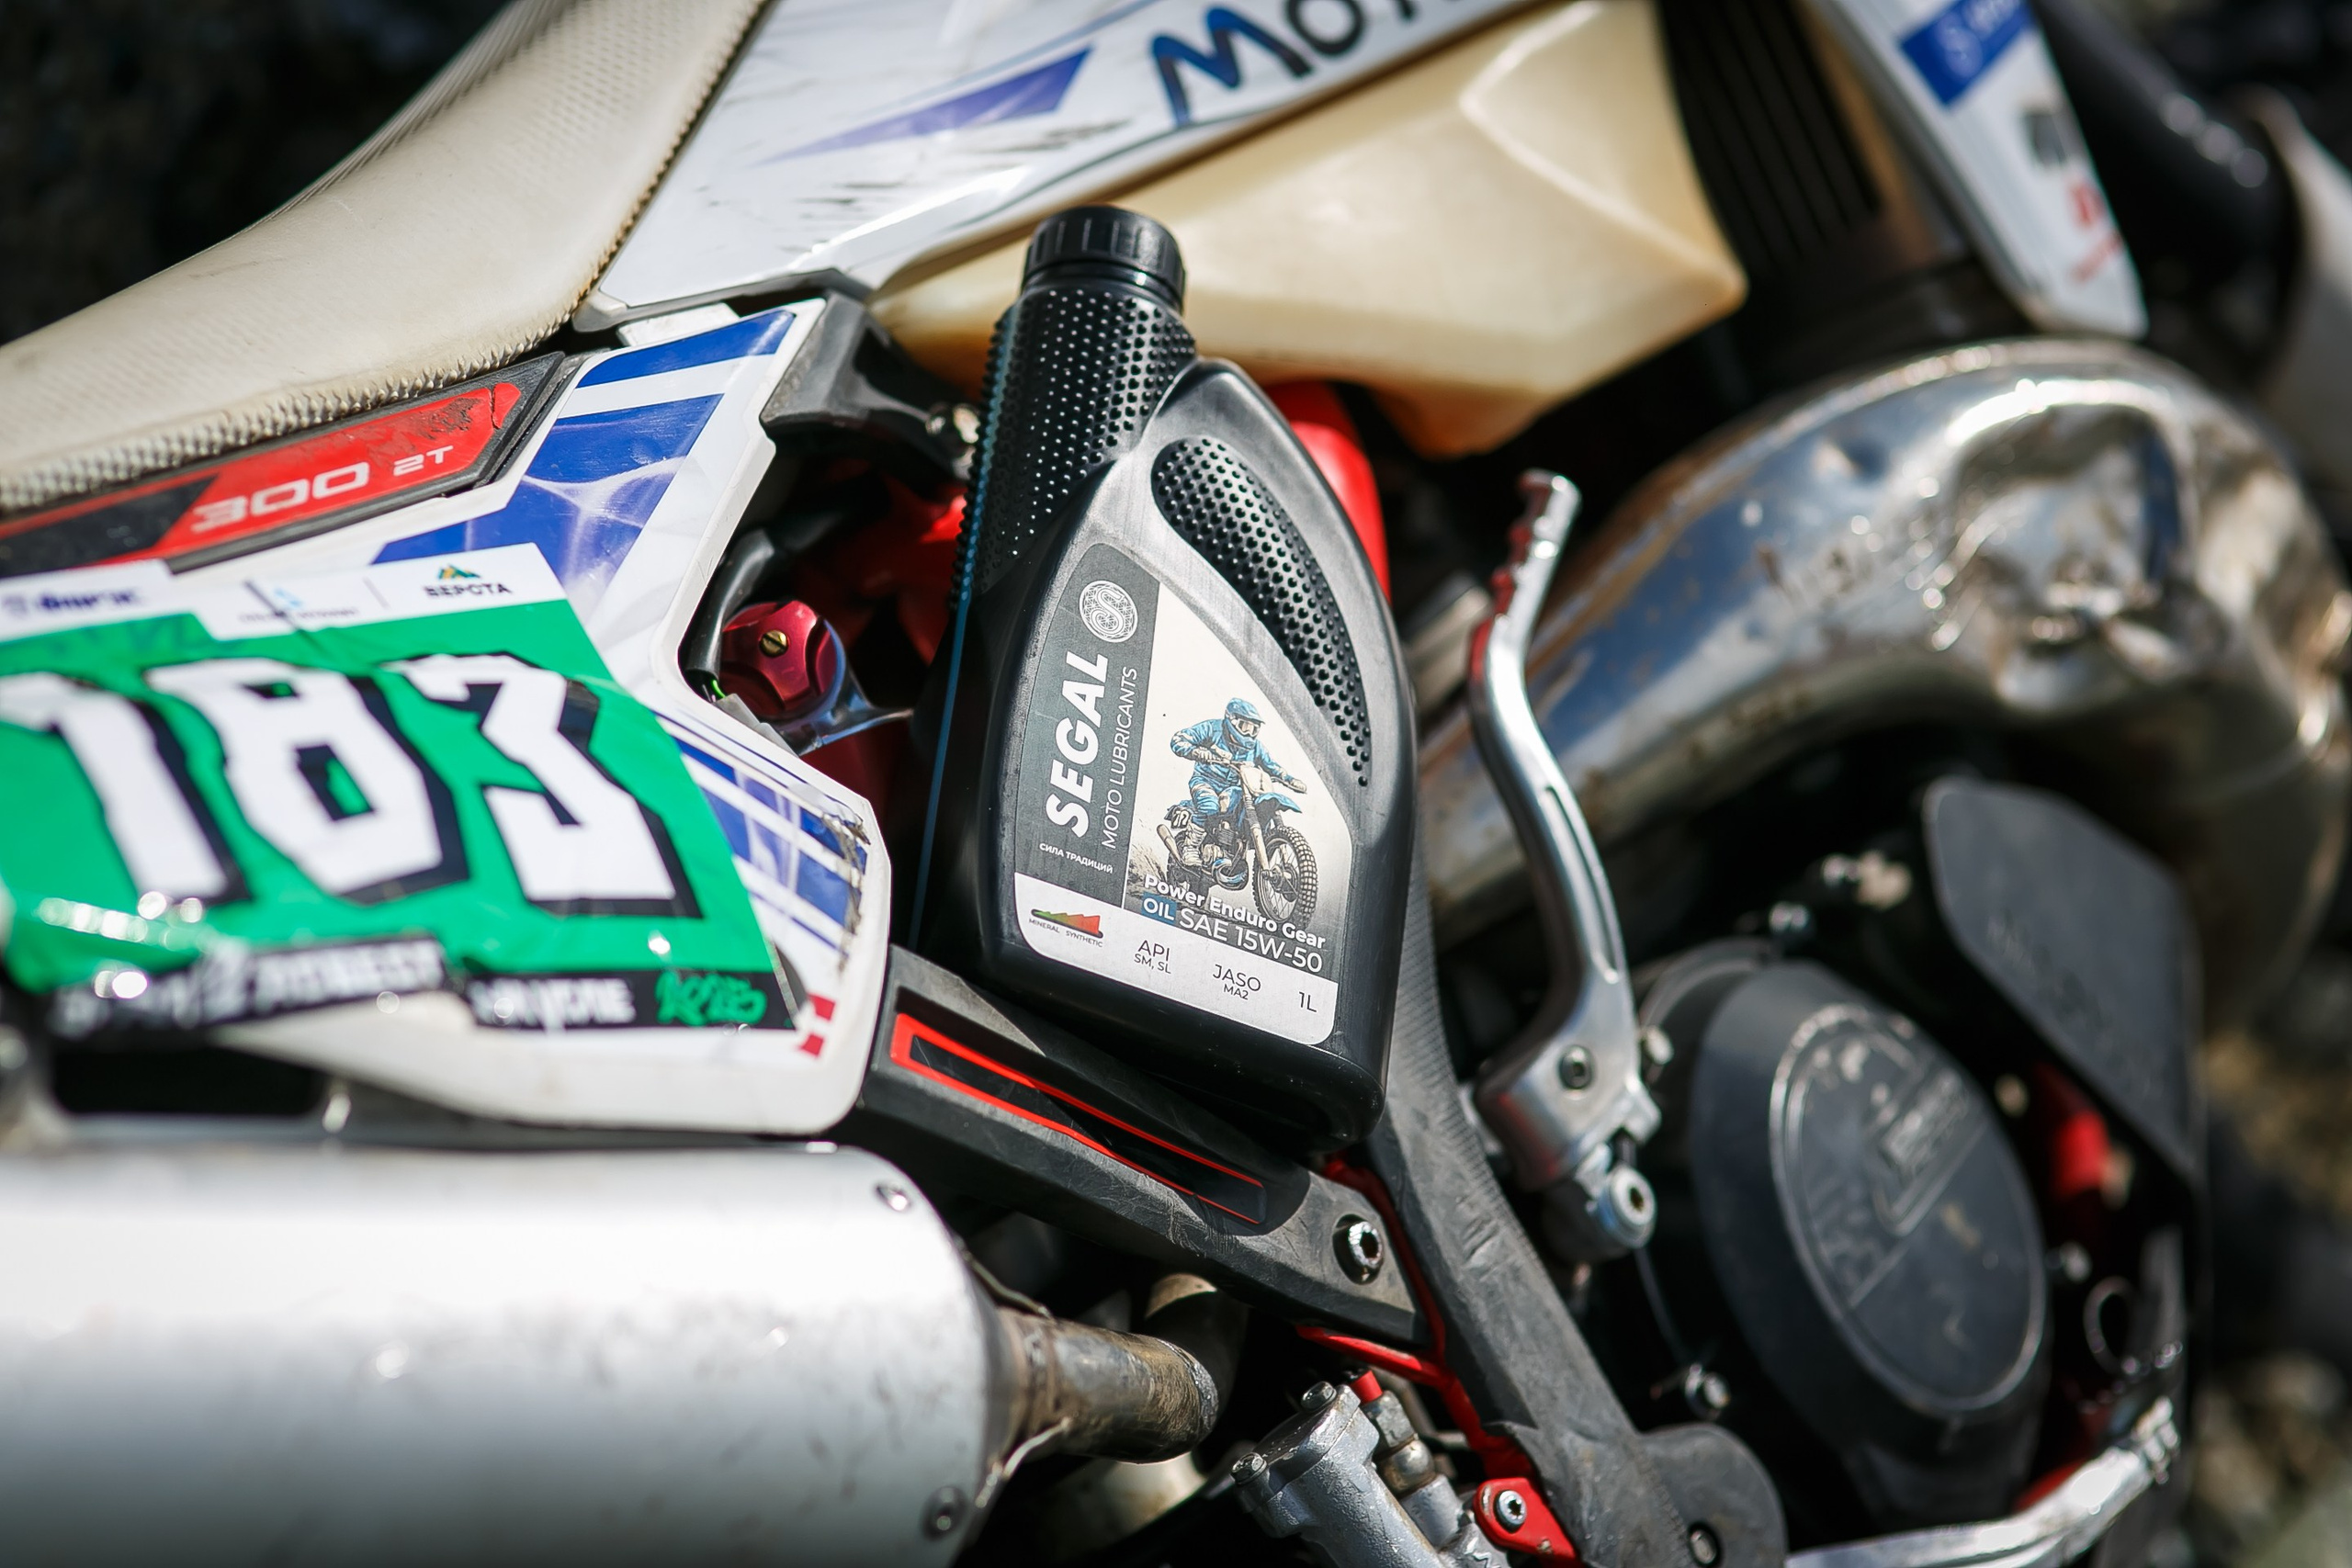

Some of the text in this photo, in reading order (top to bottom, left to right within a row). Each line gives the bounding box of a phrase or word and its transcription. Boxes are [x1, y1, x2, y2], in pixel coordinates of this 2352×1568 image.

[189, 445, 454, 534] 300 2T
[1046, 650, 1109, 838] SEGAL
[1101, 666, 1138, 850] MOTO LUBRICANTS
[0, 653, 694, 914] 183
[1039, 842, 1114, 874] СИЛА ТРАДИЦИЙ
[1144, 874, 1327, 949] Power Enduro Gear
[1028, 918, 1103, 948] MINERAL SYNTHETIC
[1143, 897, 1323, 973] OIL SAE 15W-50
[1134, 953, 1171, 975] SM, SL
[1137, 940, 1170, 962] API
[1213, 964, 1261, 992] JASO
[1223, 983, 1250, 1000] MA2
[1298, 991, 1317, 1012] 1L
